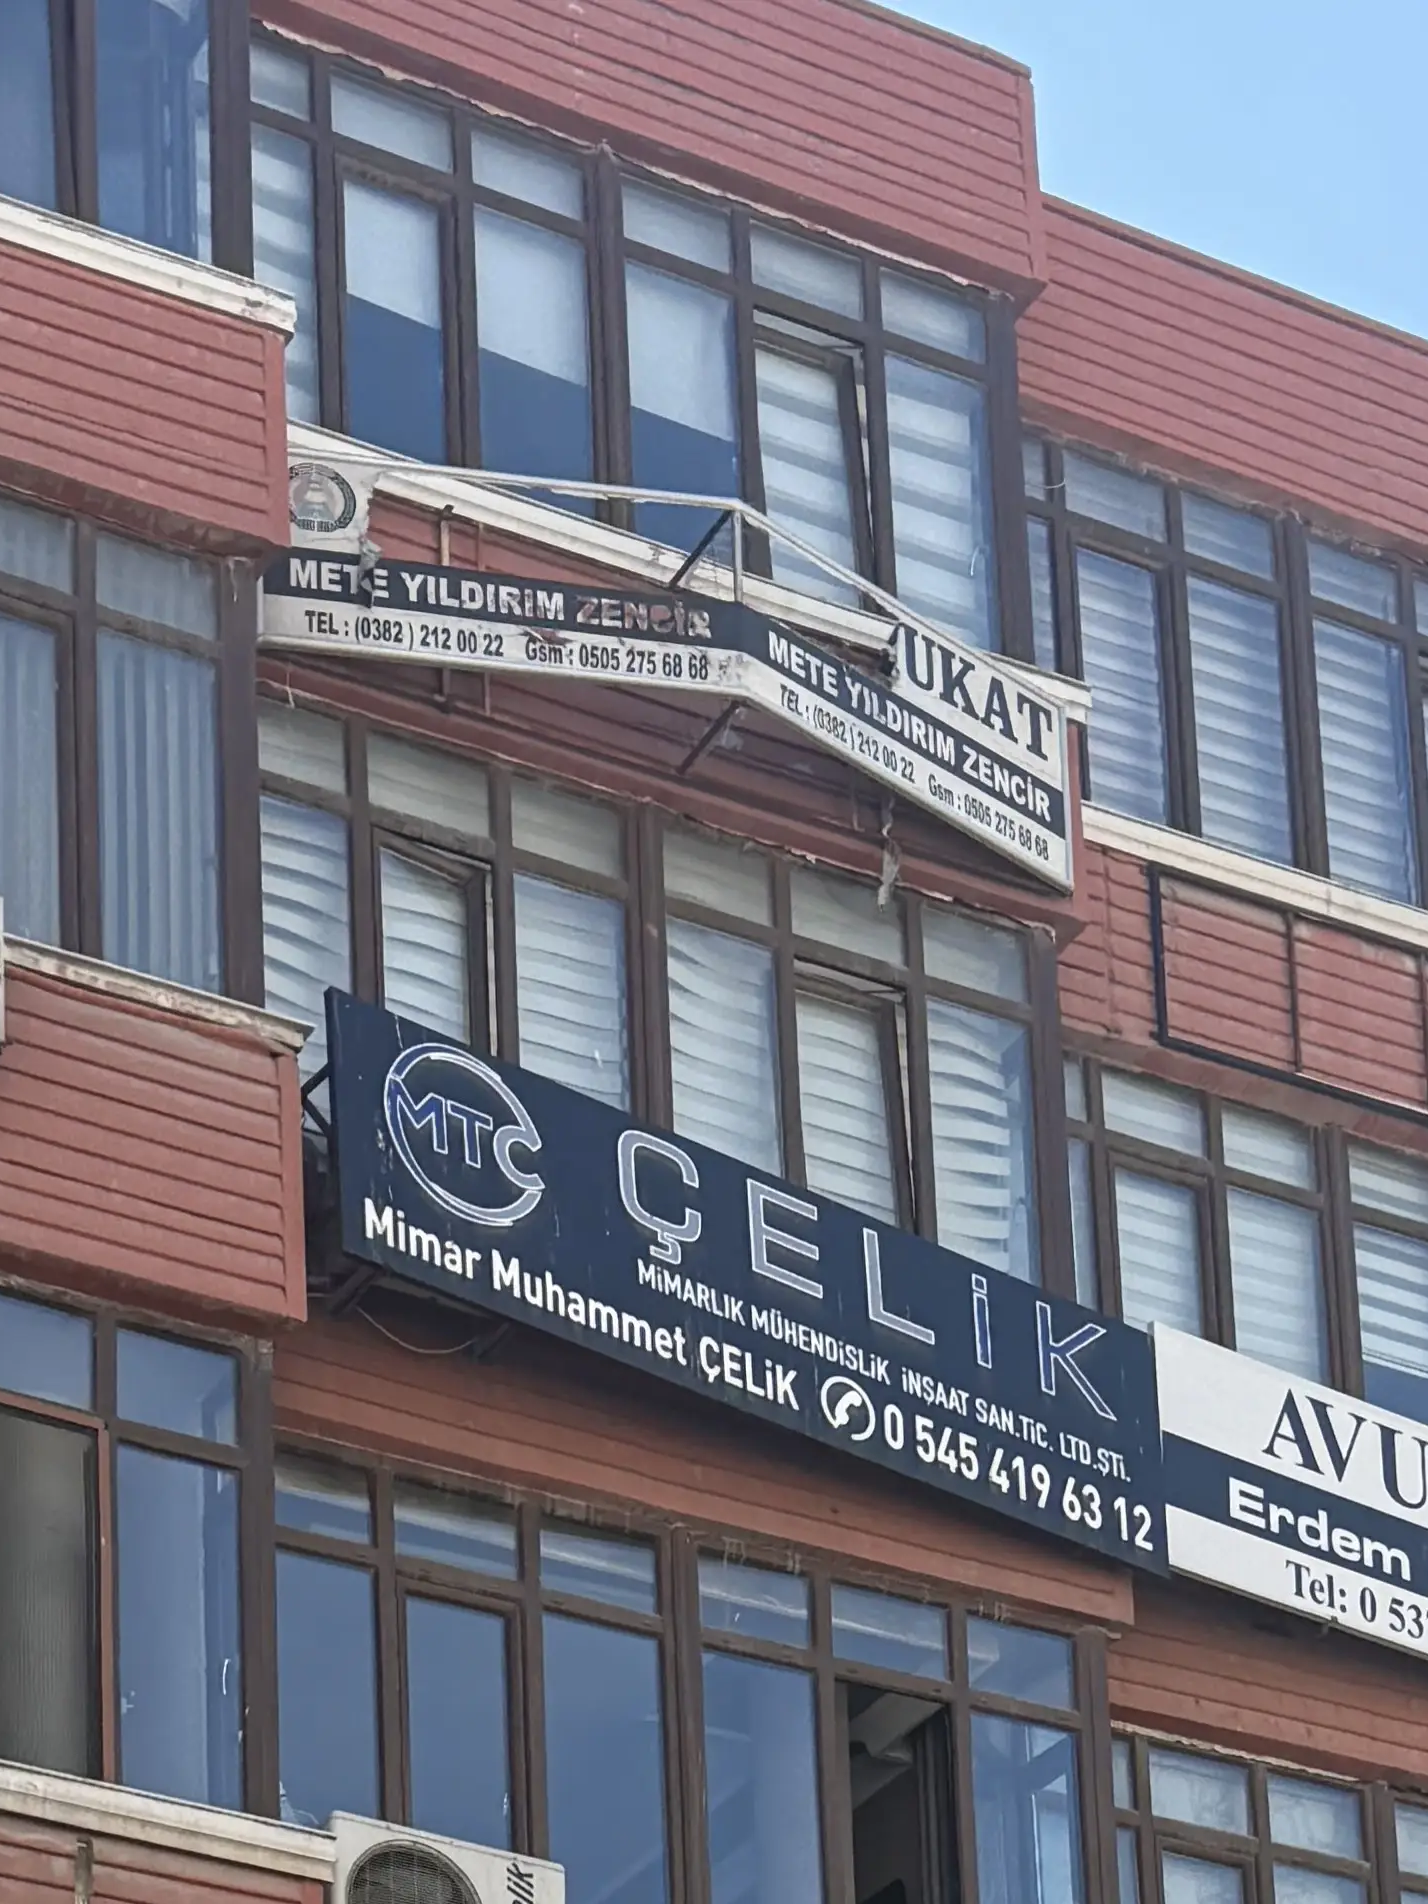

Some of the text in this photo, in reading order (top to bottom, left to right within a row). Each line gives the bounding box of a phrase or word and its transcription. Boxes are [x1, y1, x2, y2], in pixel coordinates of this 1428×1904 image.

[290, 557, 389, 599] METE
[400, 571, 564, 622] YILDIRIM
[578, 644, 620, 670] 0505
[768, 630, 1051, 821] METE YILDIRIM ZENCİR
[617, 1129, 1118, 1422] ÇELİK
[364, 1198, 1154, 1553] Mimar Muhammet ÇELİK 545 419 63 12
[1228, 1476, 1411, 1582] Erdem
[1285, 1559, 1348, 1615] Tel:
